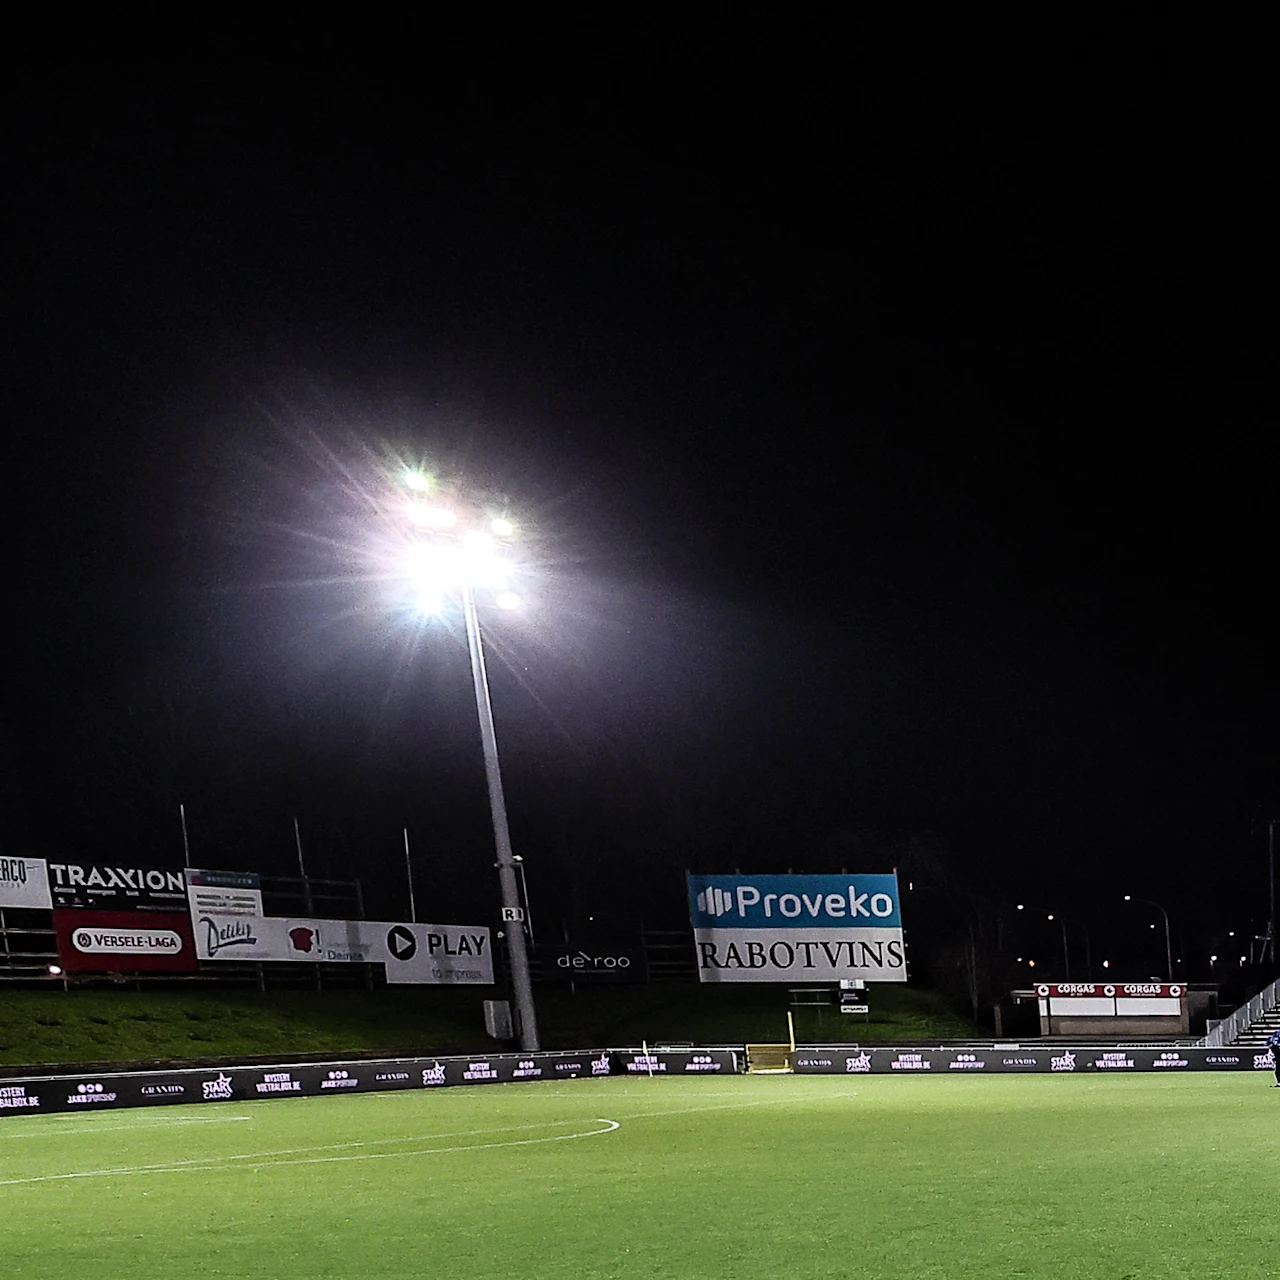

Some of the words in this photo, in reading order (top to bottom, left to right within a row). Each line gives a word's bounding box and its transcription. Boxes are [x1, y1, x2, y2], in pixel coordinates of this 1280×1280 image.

[50, 864, 185, 892] TRAXXION
[736, 885, 894, 918] Proveko
[94, 934, 178, 948] VERSELE-LAGA
[428, 934, 485, 956] PLAY
[698, 941, 904, 969] RABOTVINS
[1057, 984, 1096, 994] CORGAS
[1123, 984, 1162, 994] CORGAS
